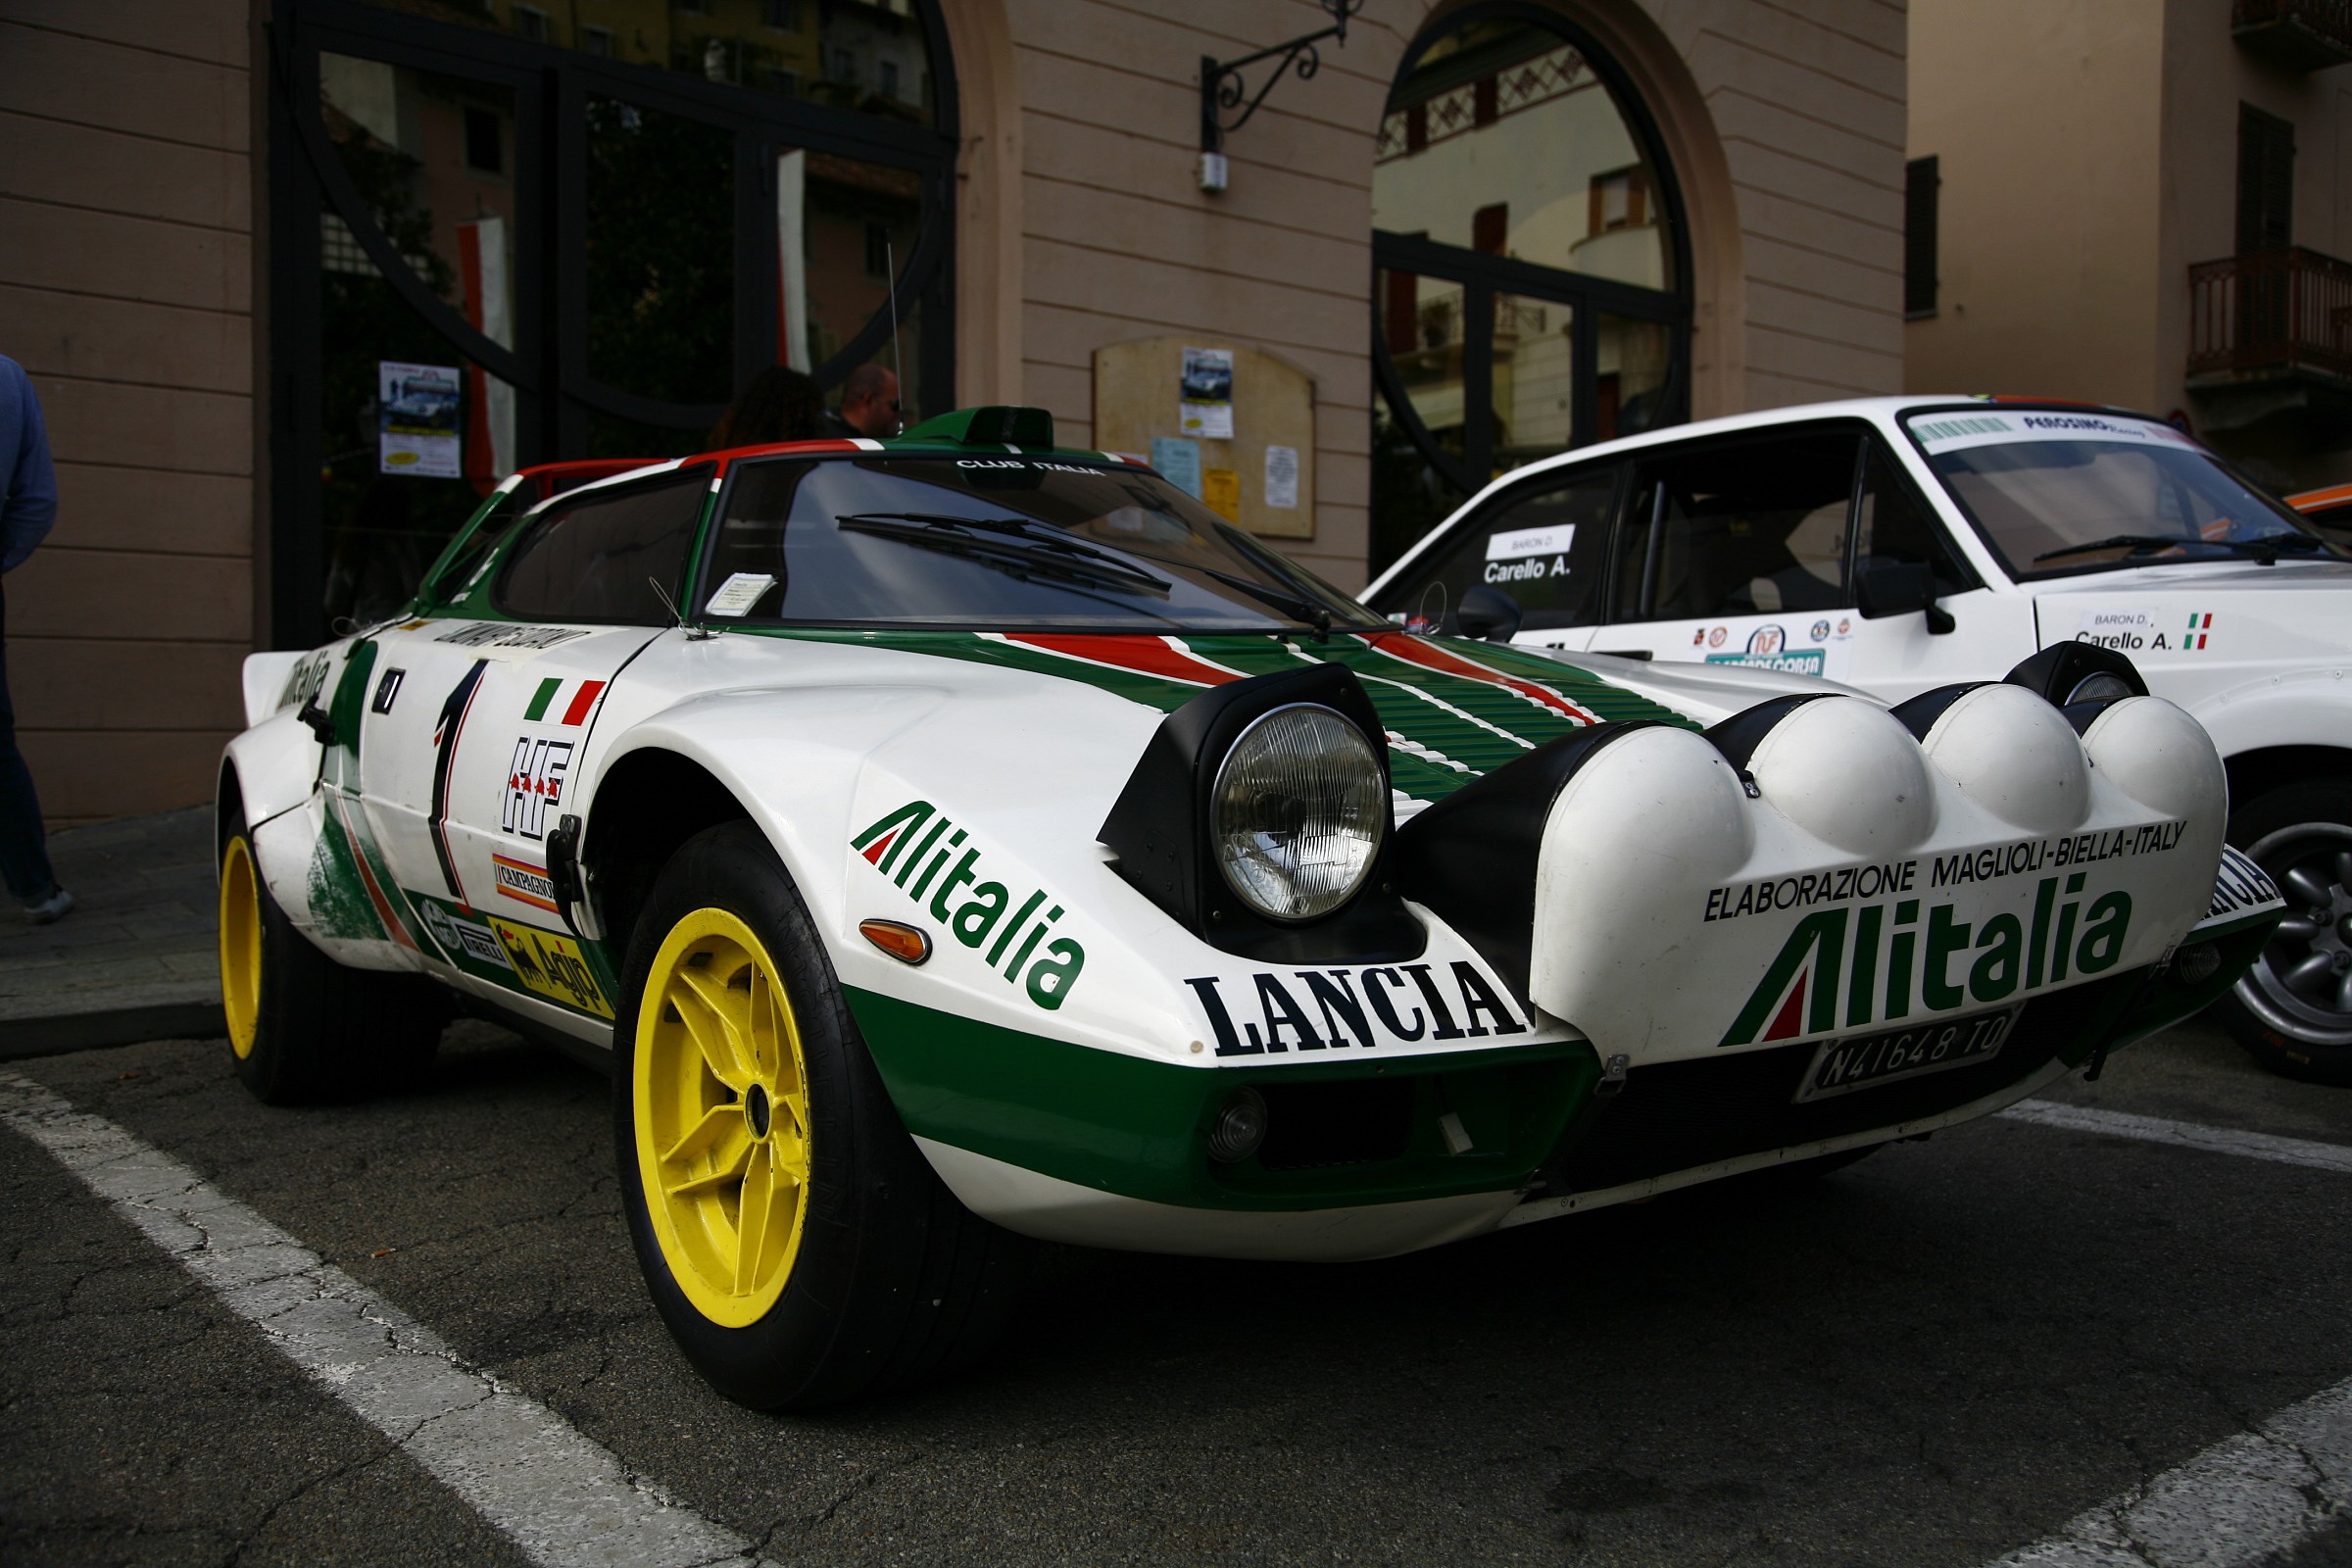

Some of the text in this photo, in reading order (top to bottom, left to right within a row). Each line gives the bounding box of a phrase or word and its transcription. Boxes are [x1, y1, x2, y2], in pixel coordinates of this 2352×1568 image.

[956, 459, 1106, 477] CLUB ITALIA
[1484, 555, 1571, 584] Carello A.
[2095, 615, 2133, 625] BARON
[2151, 633, 2172, 649] A.
[502, 736, 575, 840] HF
[850, 800, 1086, 1011] Alitalia
[1703, 820, 2187, 922] ELABORAZIONE MAGLIOLI-BIELLA-ITALY
[454, 923, 507, 963] PIRELLI
[530, 933, 602, 1011] Agip
[1718, 871, 2132, 1048] Alitalia
[1183, 960, 1527, 1057] LANCIA
